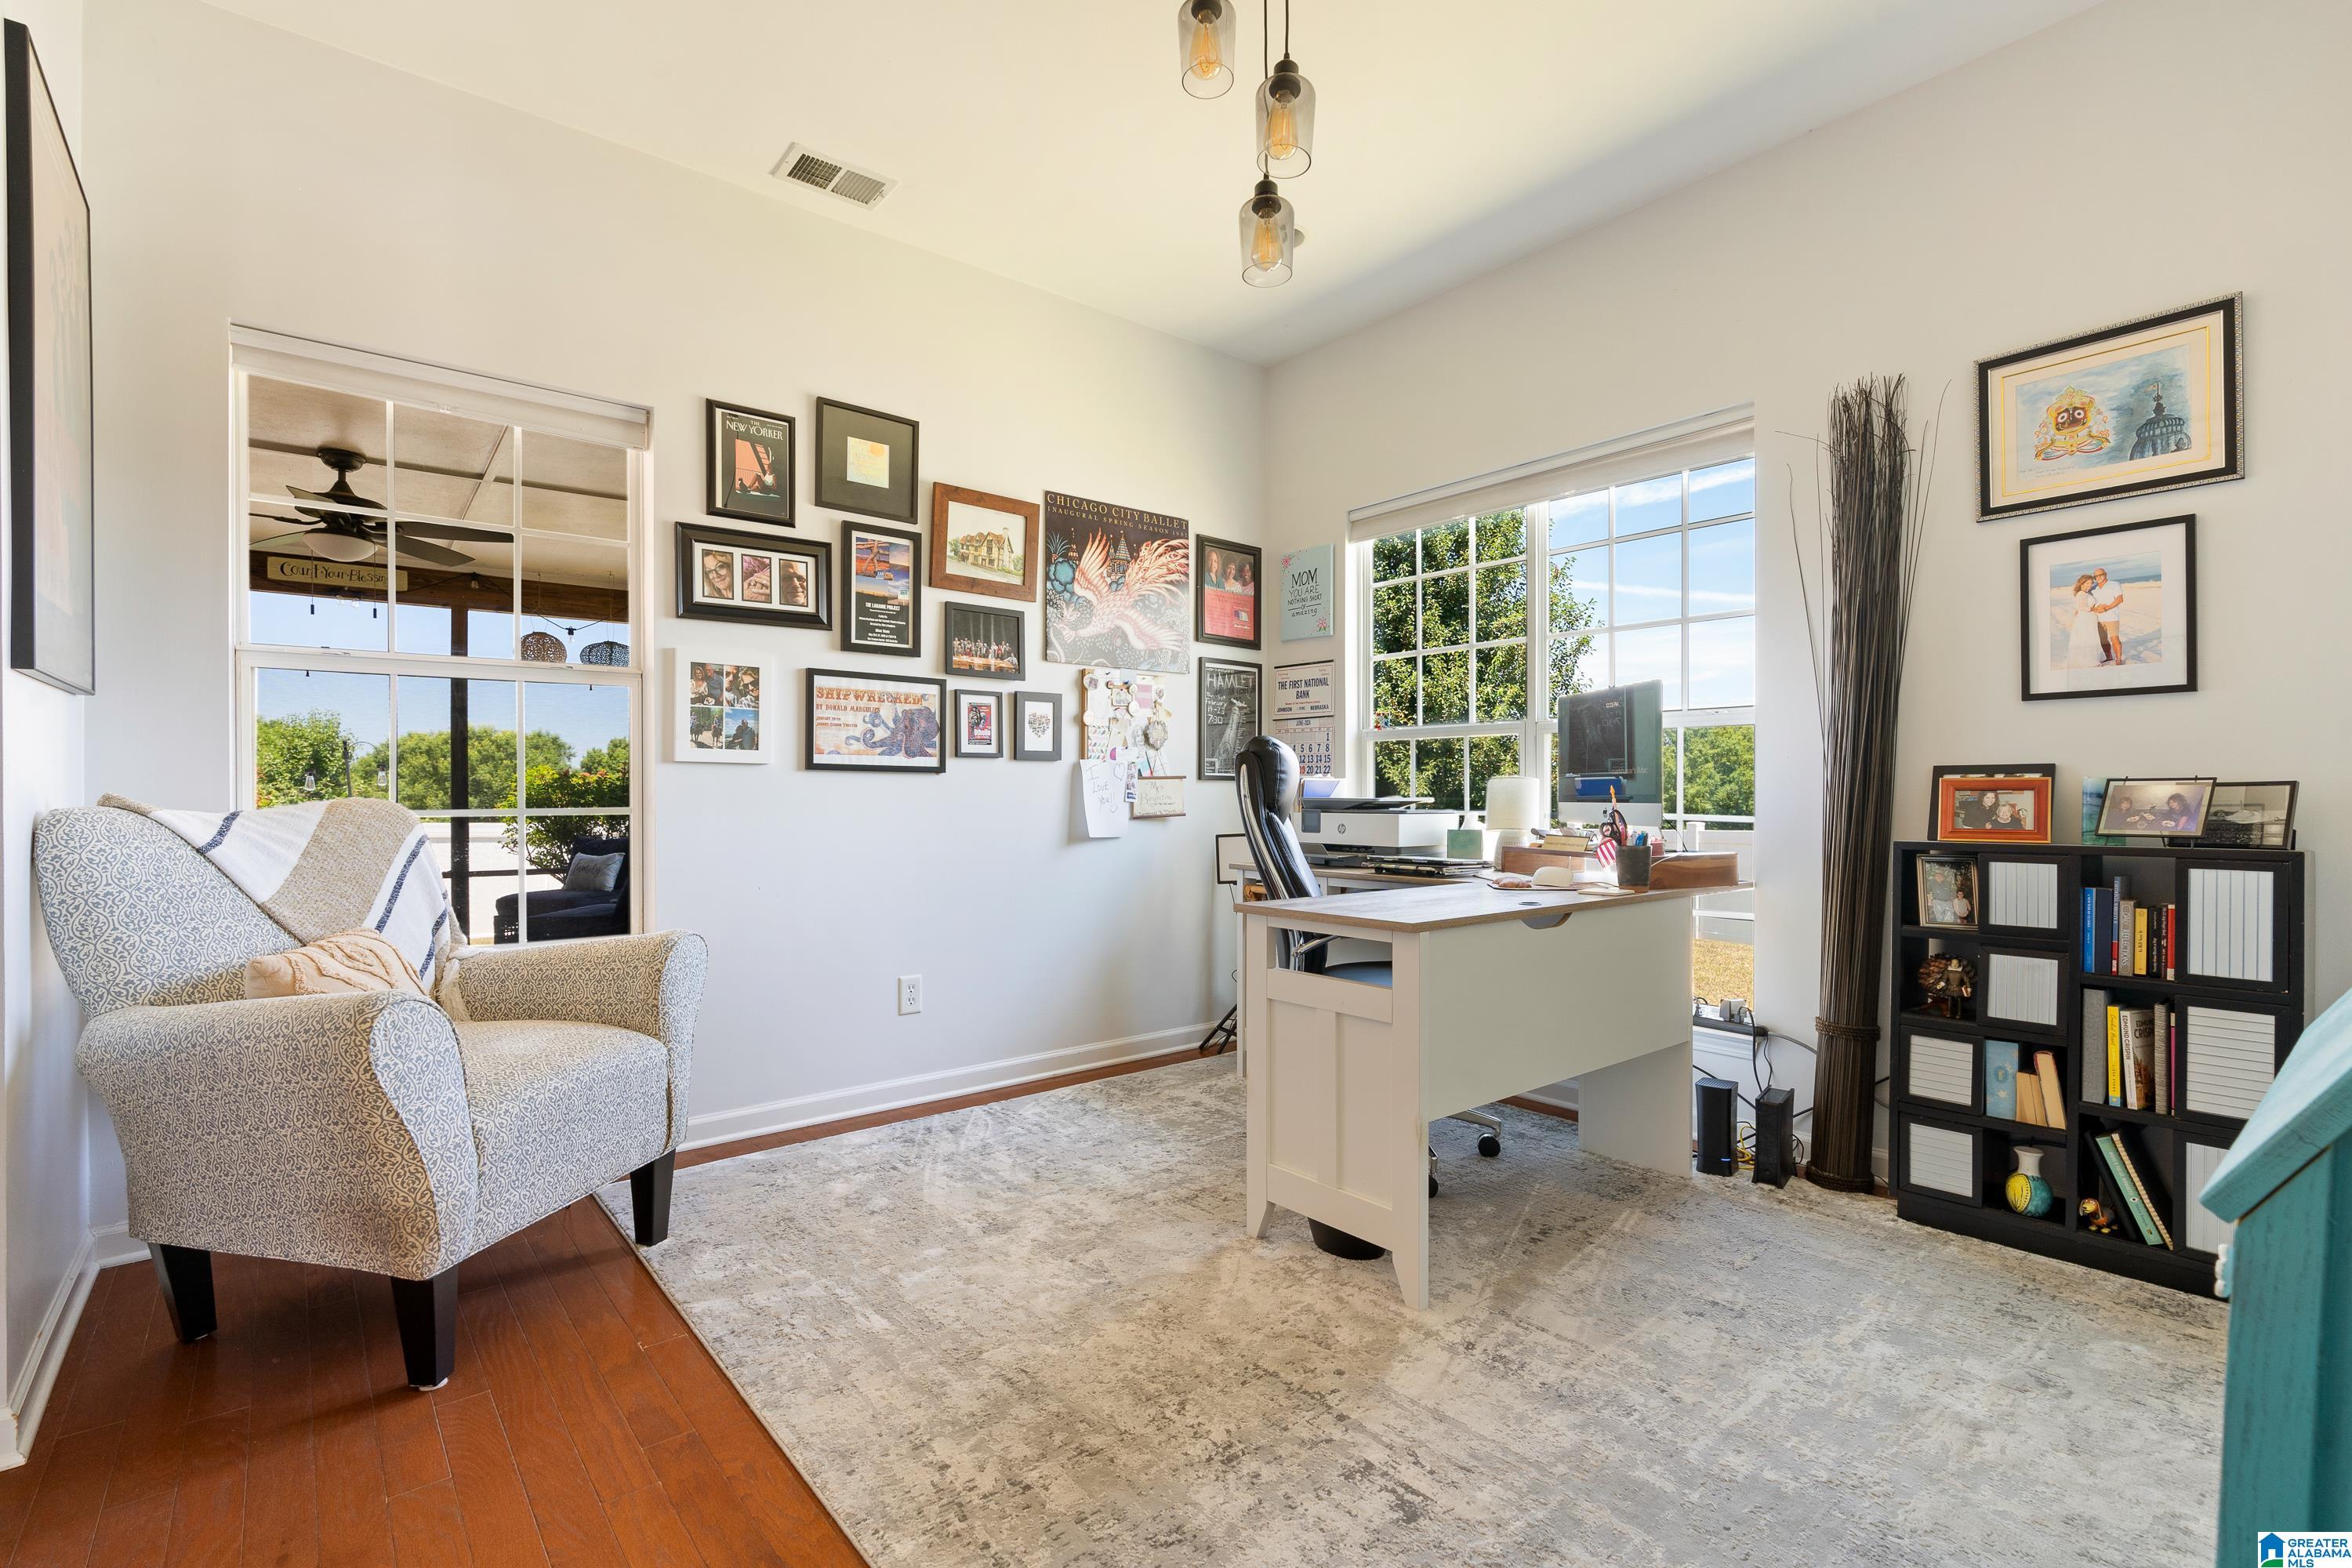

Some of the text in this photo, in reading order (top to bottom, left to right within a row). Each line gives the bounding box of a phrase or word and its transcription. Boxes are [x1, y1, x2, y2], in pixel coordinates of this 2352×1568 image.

[726, 420, 783, 441] NEW YORKER
[1047, 493, 1189, 530] CHICAGO CITY BALLET
[1047, 506, 1098, 521] INAUGURAL
[1103, 517, 1134, 528] SPRING
[1138, 524, 1168, 535] SEASON
[350, 570, 389, 584] Blessin
[1291, 568, 1317, 588] MOM
[1287, 593, 1323, 605] NOTHING SHORT
[1288, 584, 1320, 599] YOU ARE
[1291, 608, 1318, 617] amazing
[1207, 672, 1254, 691] HAMLET
[1278, 677, 1329, 690] THE FIRST NATIONAL
[816, 688, 924, 706] SHIPWRECKED!
[1296, 690, 1310, 699] BANK
[1326, 732, 1330, 742] 1
[1301, 743, 1305, 753] 5
[1308, 743, 1313, 753] 6
[1317, 743, 1321, 753] 7
[1325, 743, 1330, 753] 8
[1299, 754, 1331, 764] 12 13 14 15
[1085, 764, 1099, 782] I
[1306, 765, 1314, 775] 20
[1315, 765, 1323, 775] 21
[1323, 764, 1331, 775] 22
[2122, 928, 2130, 966] REFLECTIONS
[2122, 1015, 2130, 1039] EDMUND
